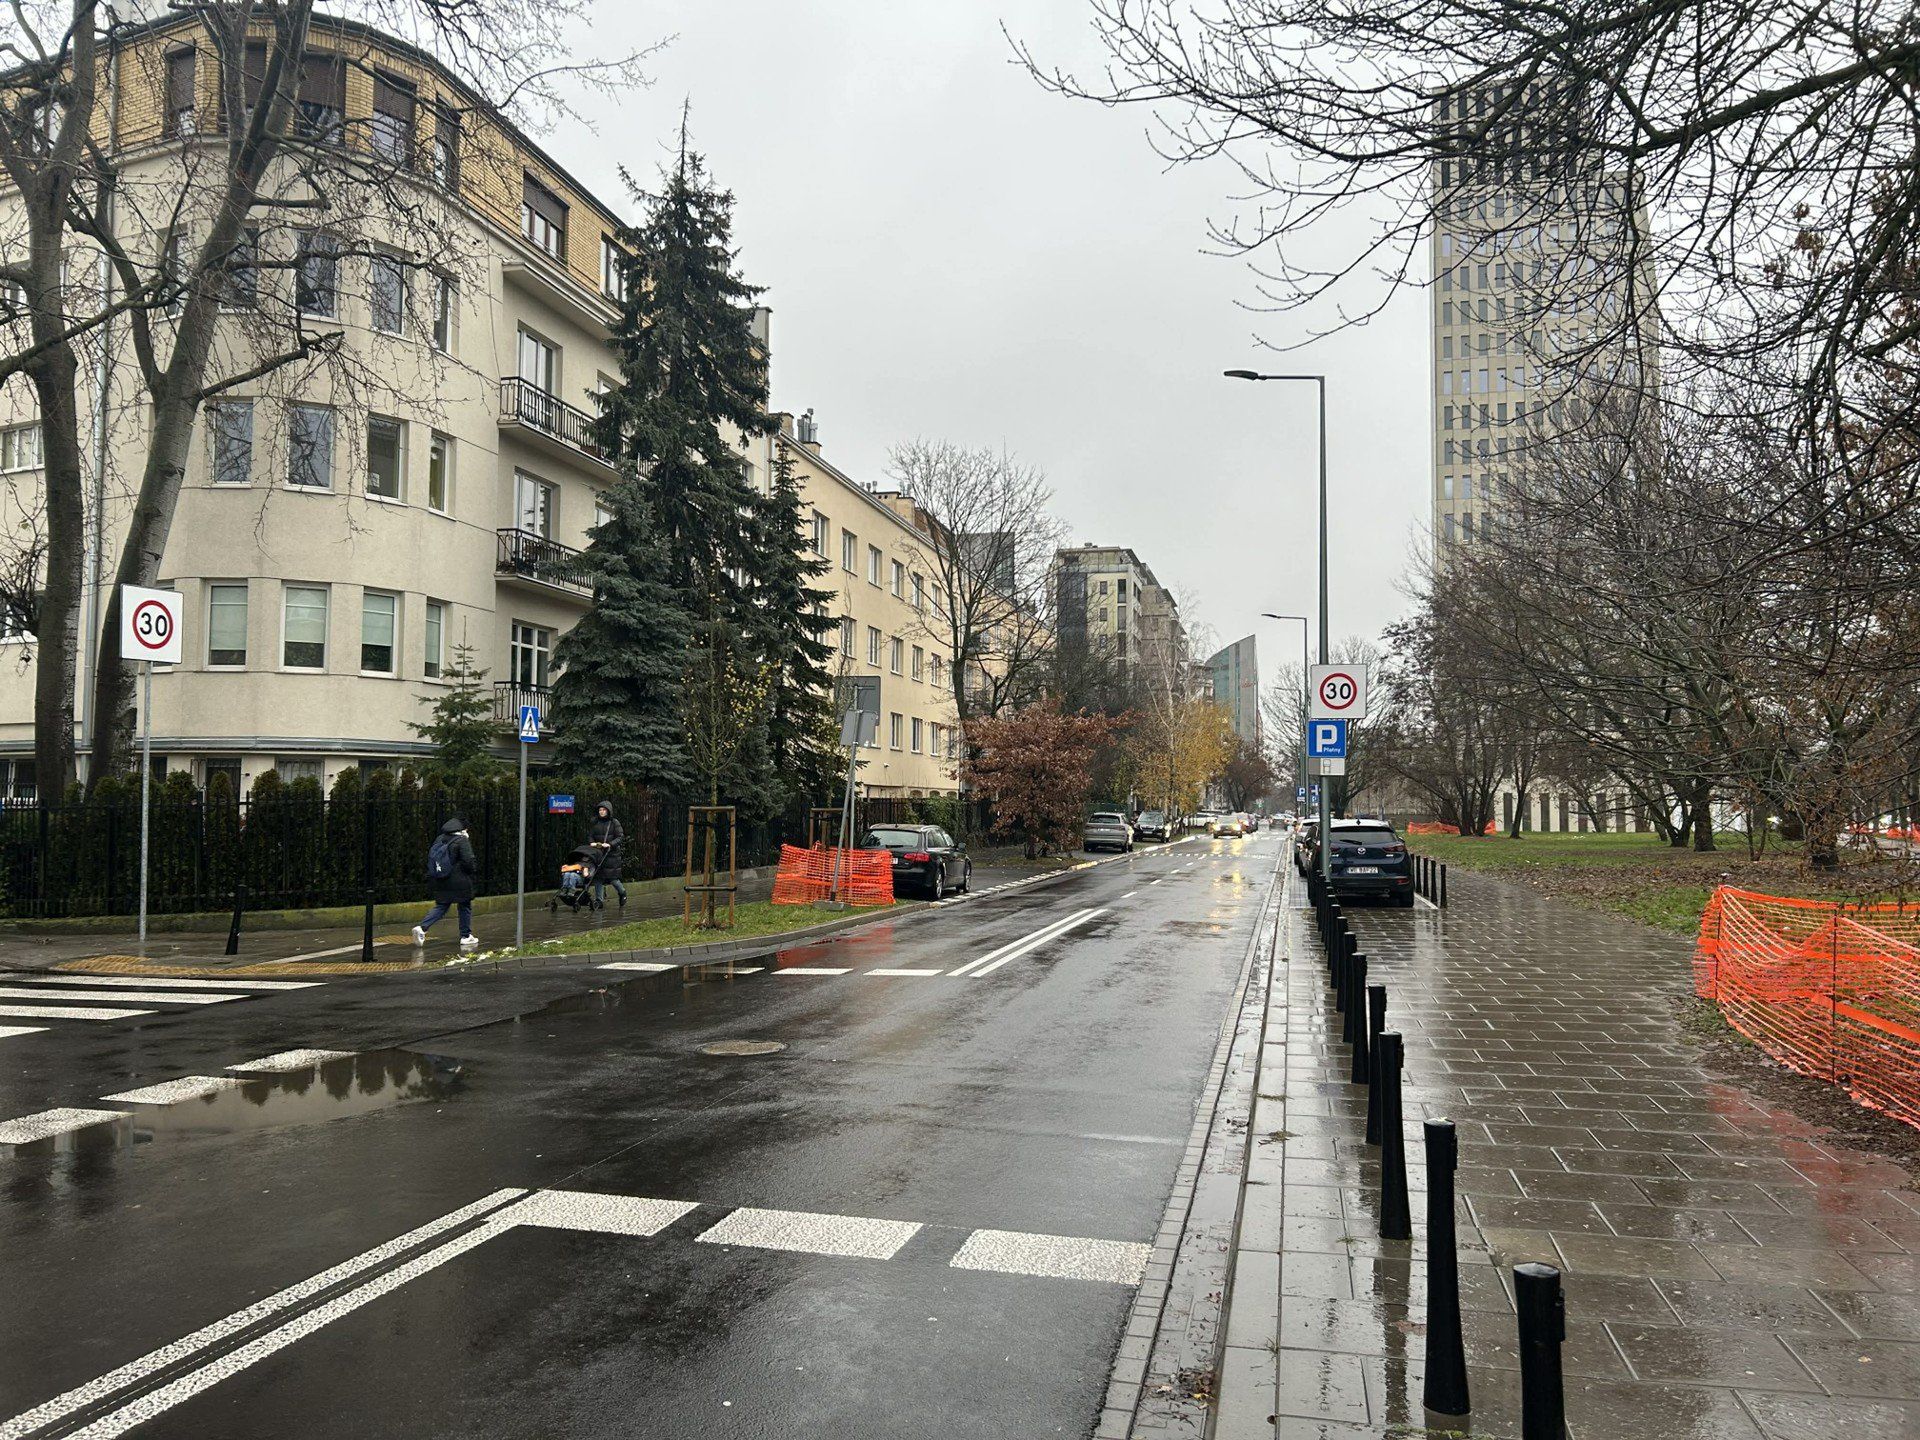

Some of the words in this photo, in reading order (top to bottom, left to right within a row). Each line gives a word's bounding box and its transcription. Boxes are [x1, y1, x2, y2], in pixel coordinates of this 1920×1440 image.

[140, 612, 168, 637] 30
[1326, 683, 1352, 700] 30
[1316, 724, 1337, 753] P
[1298, 787, 1306, 796] P
